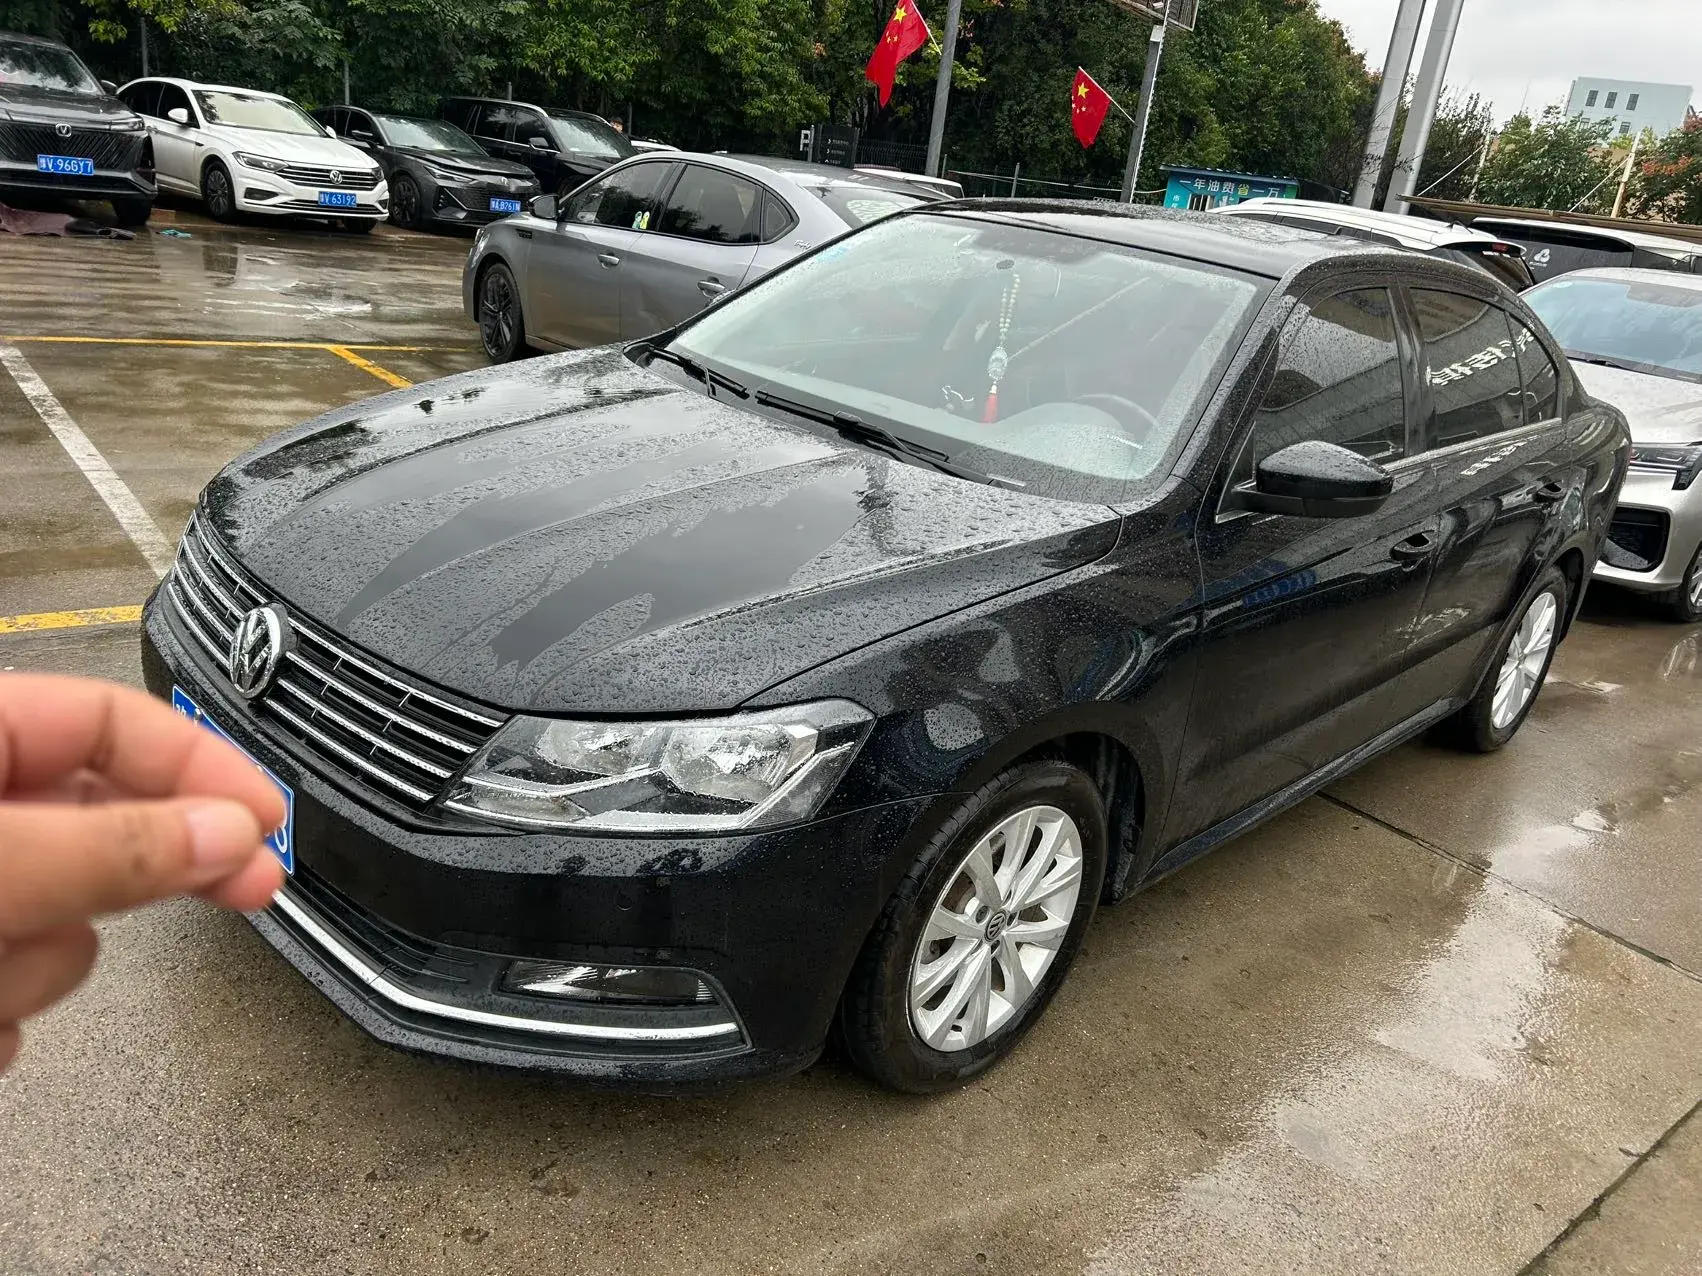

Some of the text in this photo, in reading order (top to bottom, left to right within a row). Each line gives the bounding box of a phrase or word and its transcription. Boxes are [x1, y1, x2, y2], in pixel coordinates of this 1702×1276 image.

[1179, 178, 1280, 199] 一年油费省一万
